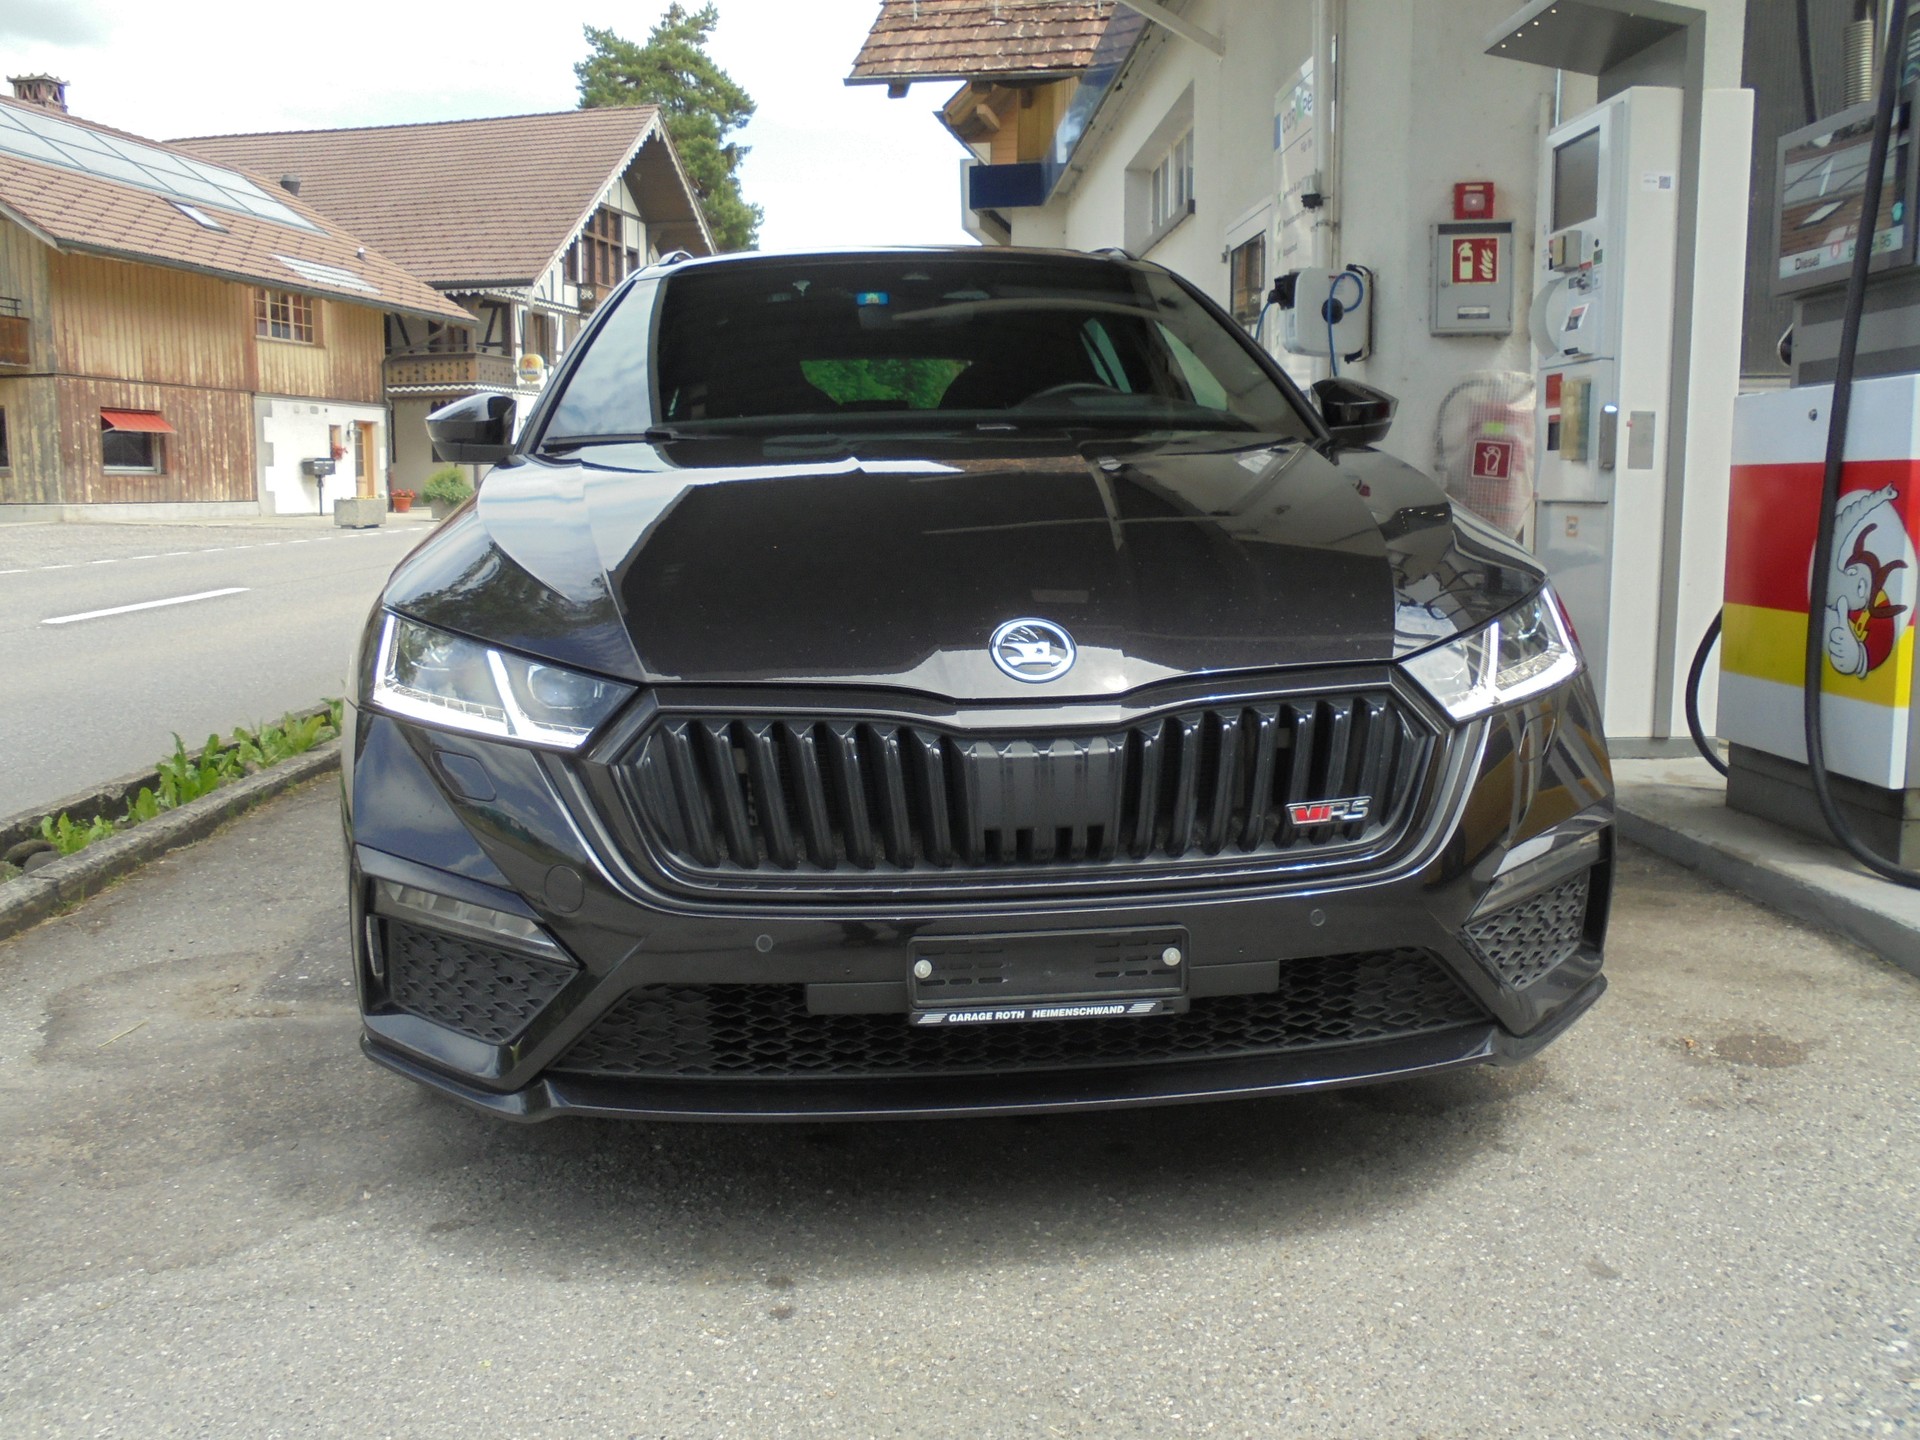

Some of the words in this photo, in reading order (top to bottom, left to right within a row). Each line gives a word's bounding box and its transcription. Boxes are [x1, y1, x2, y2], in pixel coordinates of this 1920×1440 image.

[1795, 254, 1821, 271] Diesel
[948, 1012, 993, 1022] GARAGE
[995, 1010, 1025, 1020] ROTH
[1032, 1005, 1125, 1018] HEIMENSCHWAND
